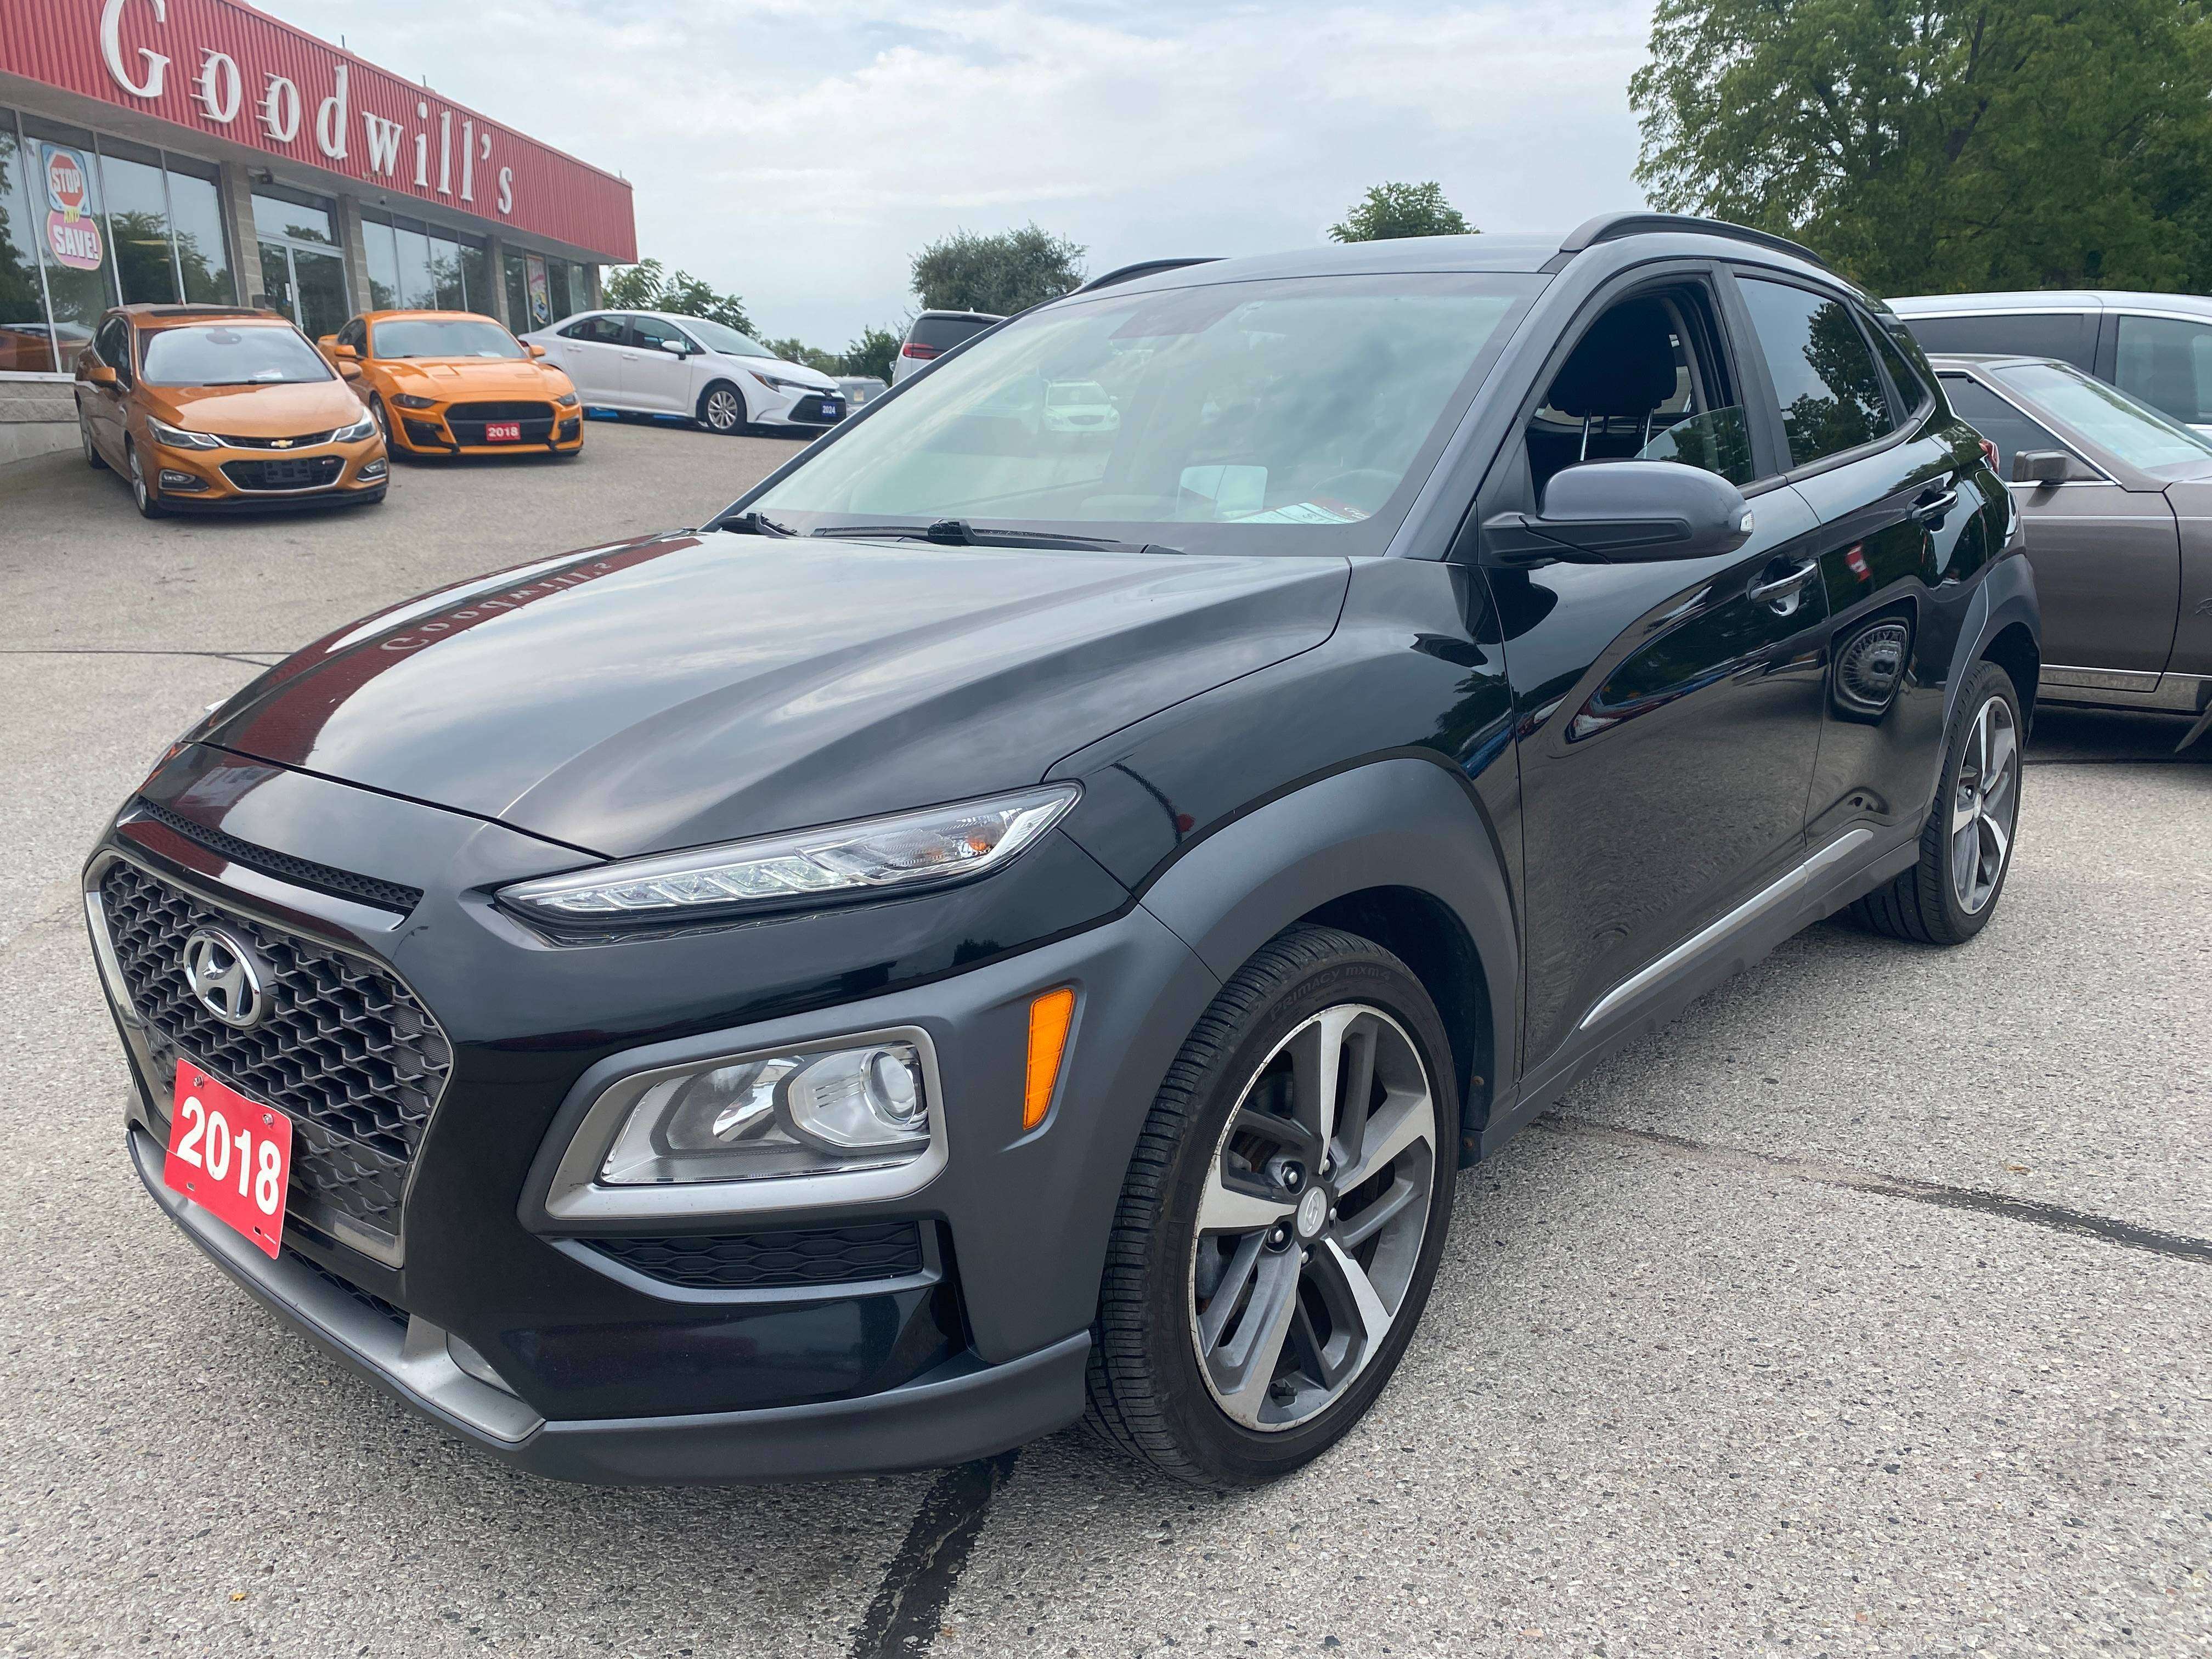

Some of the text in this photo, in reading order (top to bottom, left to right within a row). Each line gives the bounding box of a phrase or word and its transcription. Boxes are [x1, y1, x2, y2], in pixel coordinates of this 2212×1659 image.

[100, 0, 513, 215] Goodwill's
[51, 167, 82, 193] STOP
[64, 208, 80, 224] AND
[53, 224, 99, 261] SAVE!
[822, 405, 836, 414] 2024
[487, 426, 519, 438] 2018
[1269, 969, 1340, 1022] PRIMACY
[177, 1096, 281, 1216] 2018
